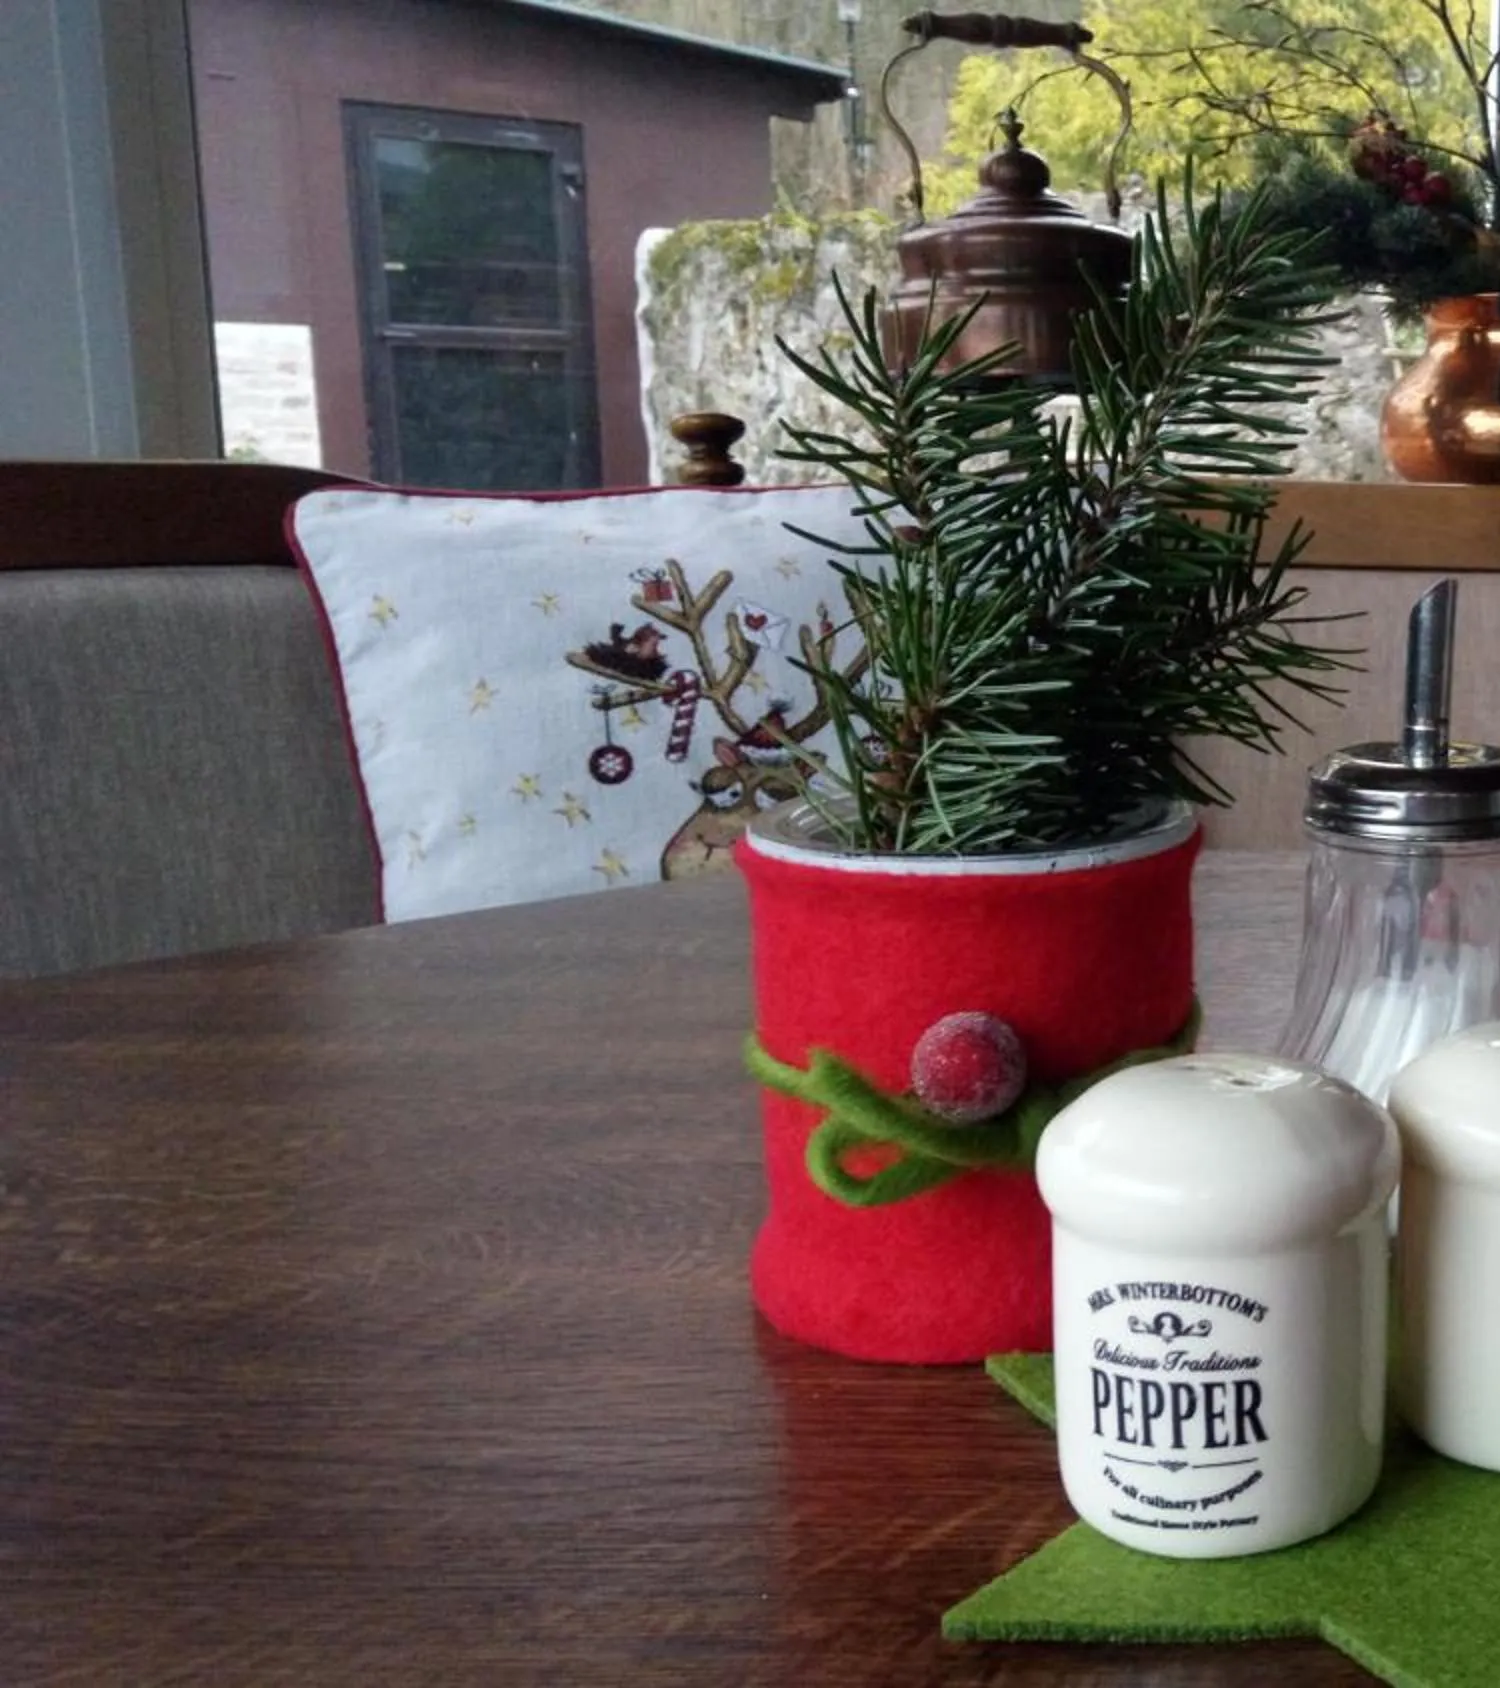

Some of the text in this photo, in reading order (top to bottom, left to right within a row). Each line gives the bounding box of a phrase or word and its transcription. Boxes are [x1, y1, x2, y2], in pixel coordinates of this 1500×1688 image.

[1117, 1282, 1269, 1323] WINTERBOTTOM'S
[1093, 1338, 1262, 1372] Delicious Traditions
[1090, 1366, 1268, 1449] PEPPER
[1122, 1485, 1138, 1499] all
[1140, 1494, 1197, 1512] culinary
